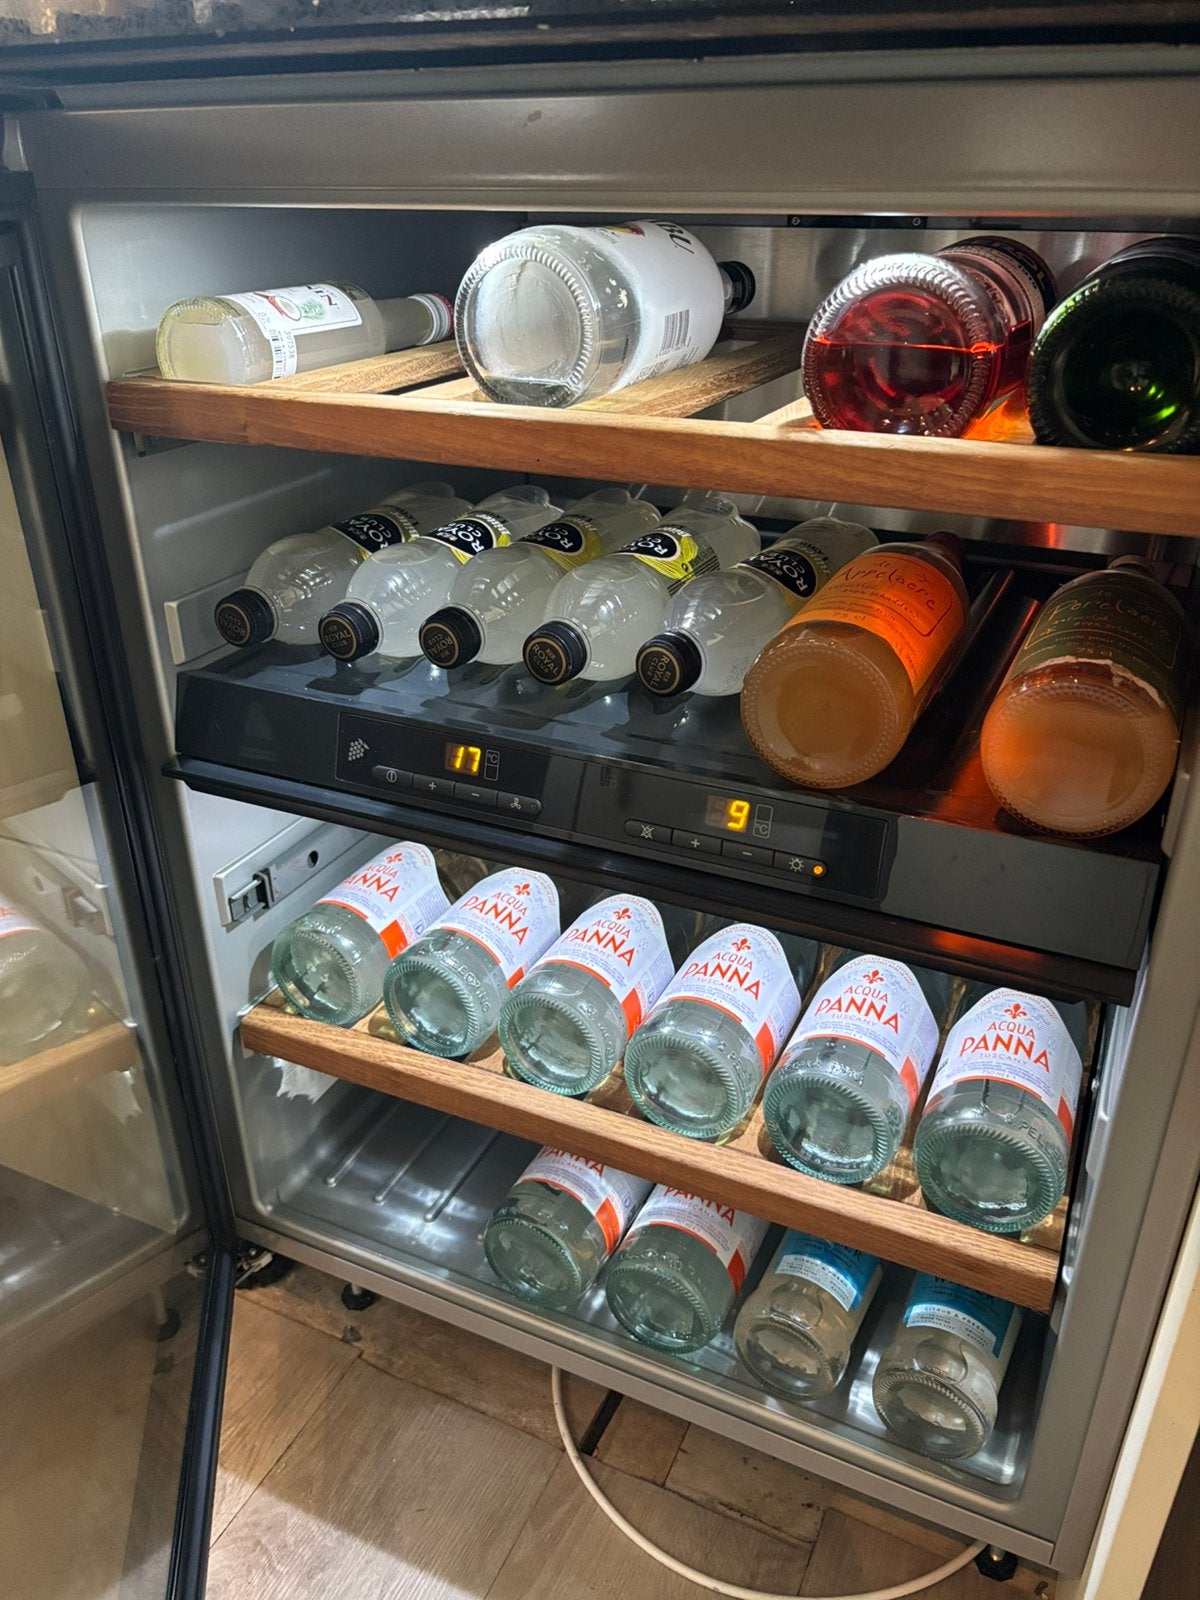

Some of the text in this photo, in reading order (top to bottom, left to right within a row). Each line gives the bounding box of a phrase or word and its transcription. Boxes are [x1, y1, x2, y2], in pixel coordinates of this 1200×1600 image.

[436, 523, 485, 553] ROYA
[758, 554, 809, 592] ROYA
[323, 629, 351, 644] ROYAL
[427, 635, 454, 657] ROYAL
[532, 643, 560, 676] ROYAL
[649, 654, 670, 687] ROYAL
[454, 745, 482, 773] 17
[727, 799, 750, 830] 9
[342, 868, 400, 903] ANNA
[365, 863, 400, 881] ACQUA
[491, 890, 530, 916] ACQUA
[459, 895, 530, 946] PANNA
[592, 918, 631, 939] ACQUA
[561, 926, 637, 968] PANNA
[711, 951, 753, 971] ACQUA
[682, 961, 761, 1001] PANNA
[843, 984, 889, 1003] ACQUA
[813, 996, 899, 1035] PANNA
[831, 1012, 877, 1027] TUSCANY
[987, 1021, 1036, 1040] ACQUA
[959, 1033, 1050, 1073] PANNA
[979, 1052, 1028, 1067] TUSCANY
